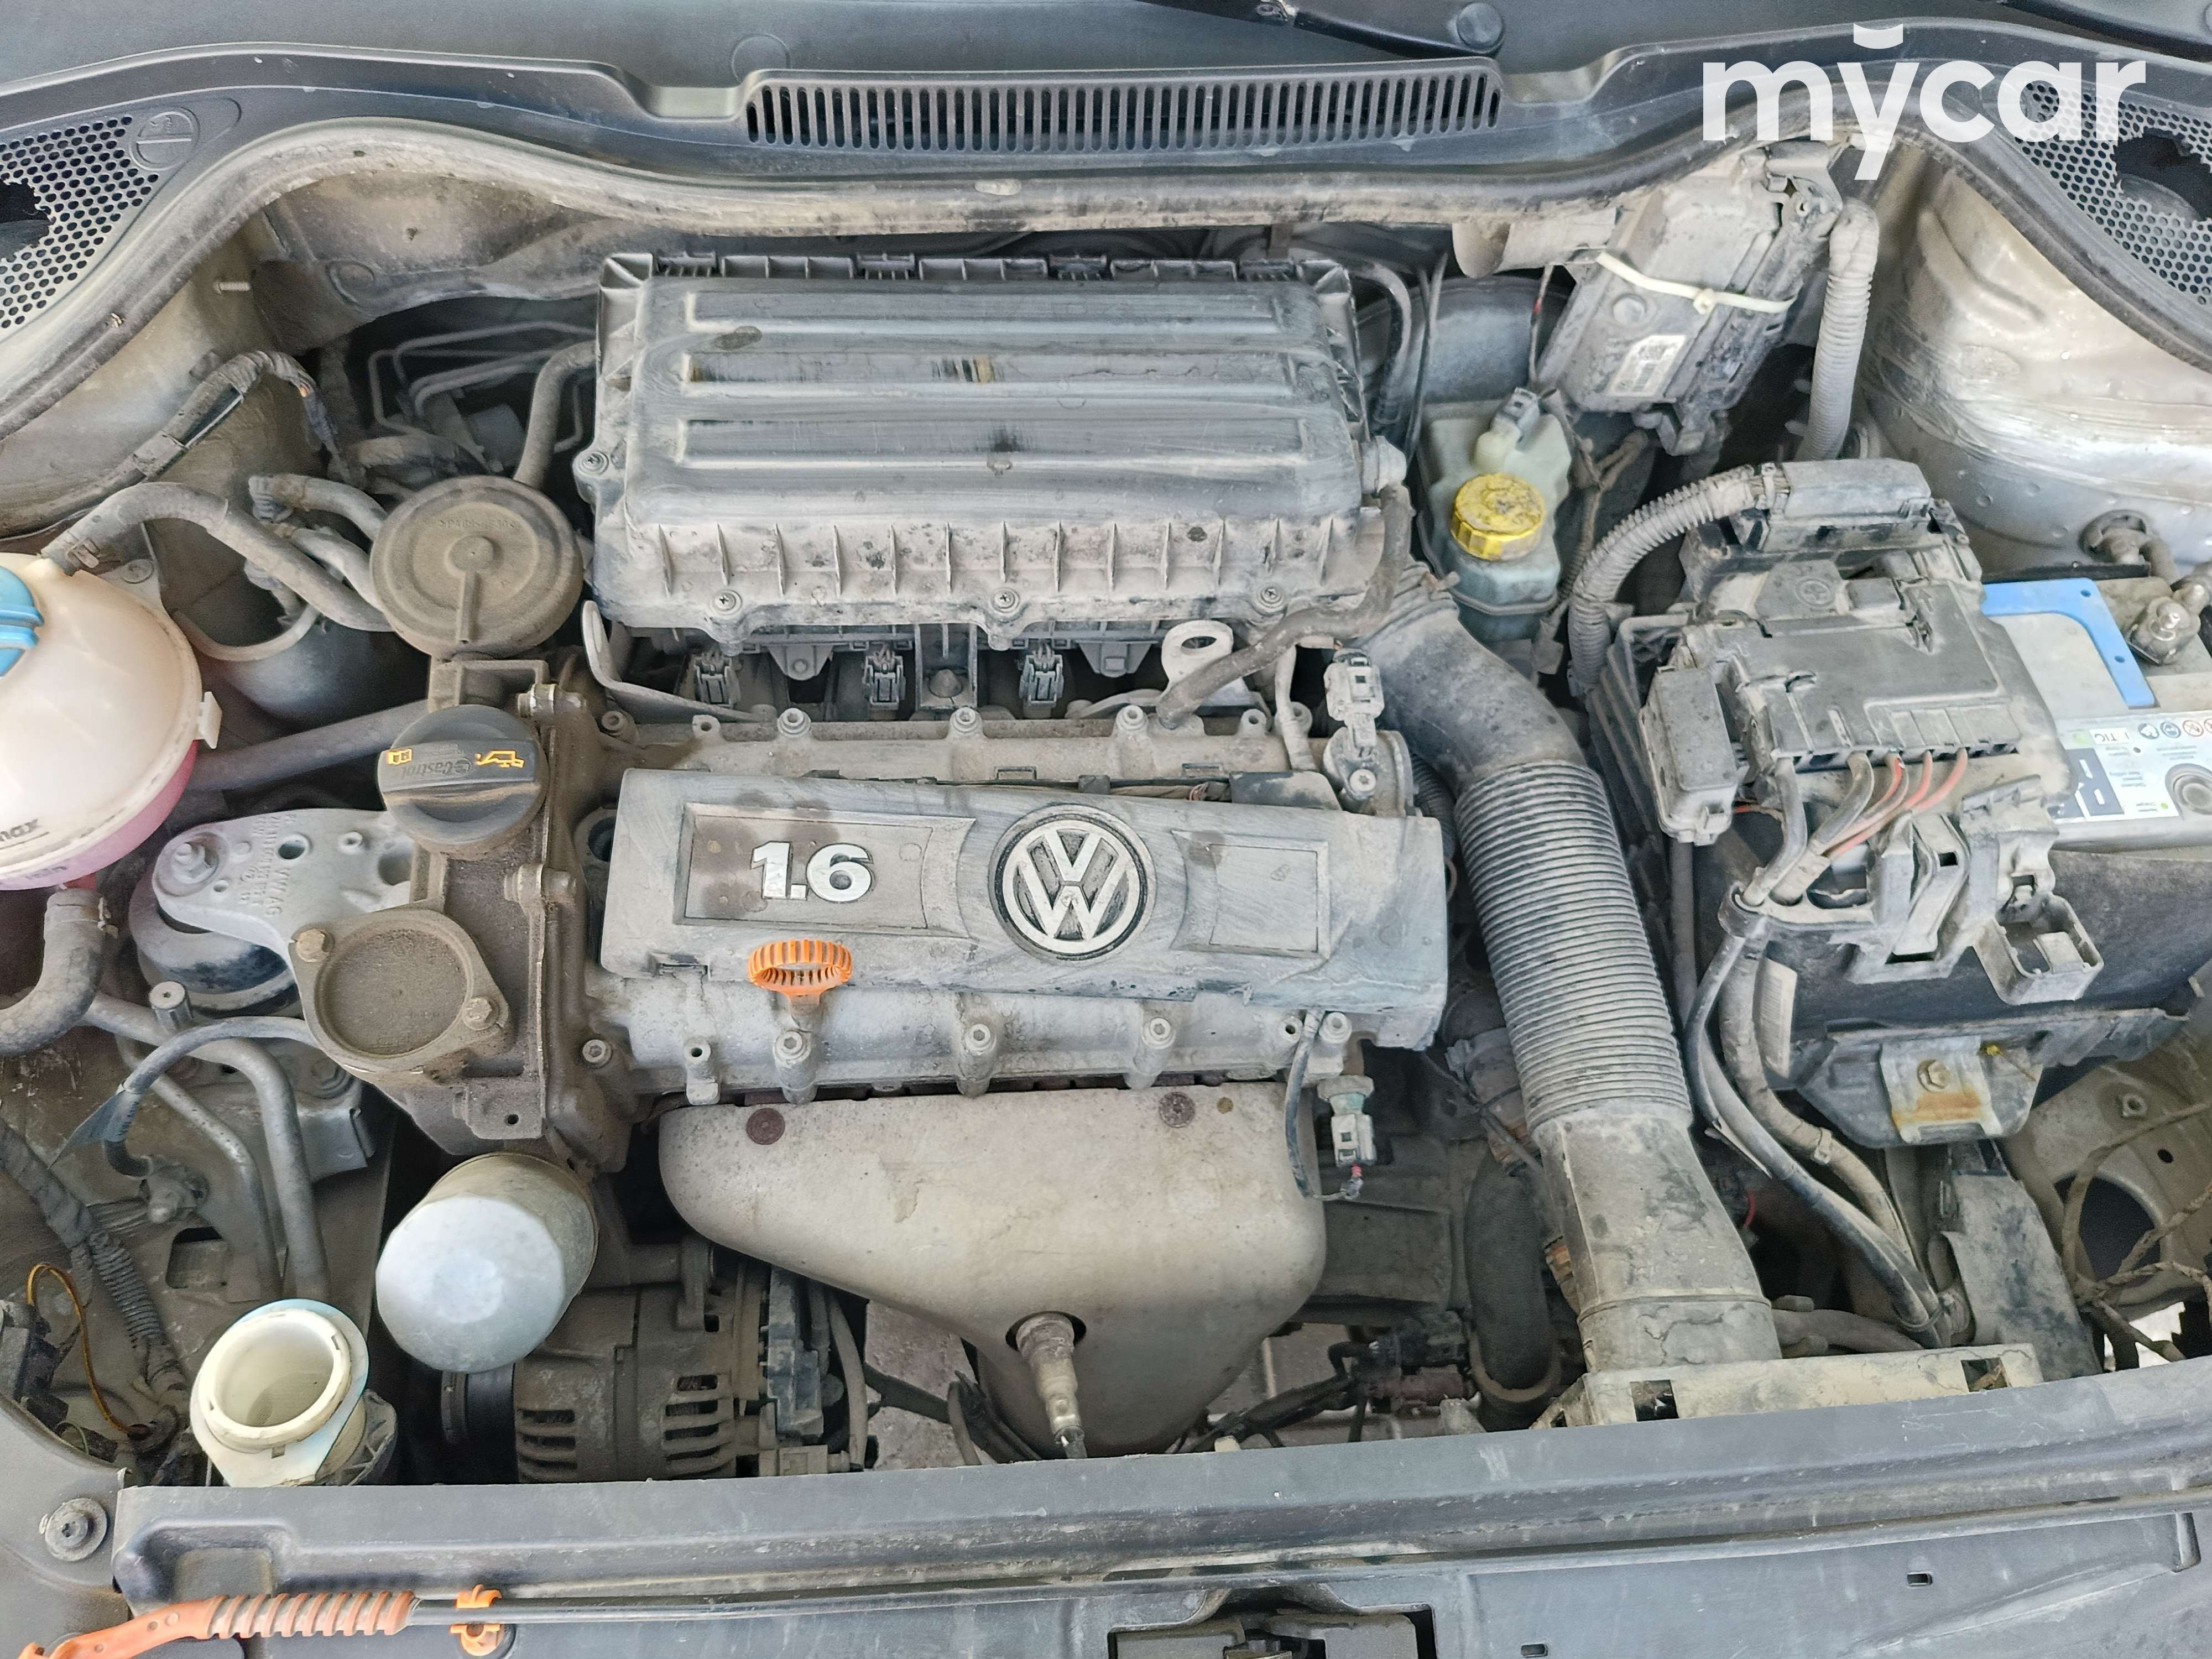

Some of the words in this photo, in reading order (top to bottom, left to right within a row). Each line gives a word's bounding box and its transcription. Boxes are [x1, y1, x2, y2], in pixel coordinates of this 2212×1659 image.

[401, 760, 453, 780] Castrol
[751, 841, 874, 902] 1.6
[1010, 823, 1134, 947] VW
